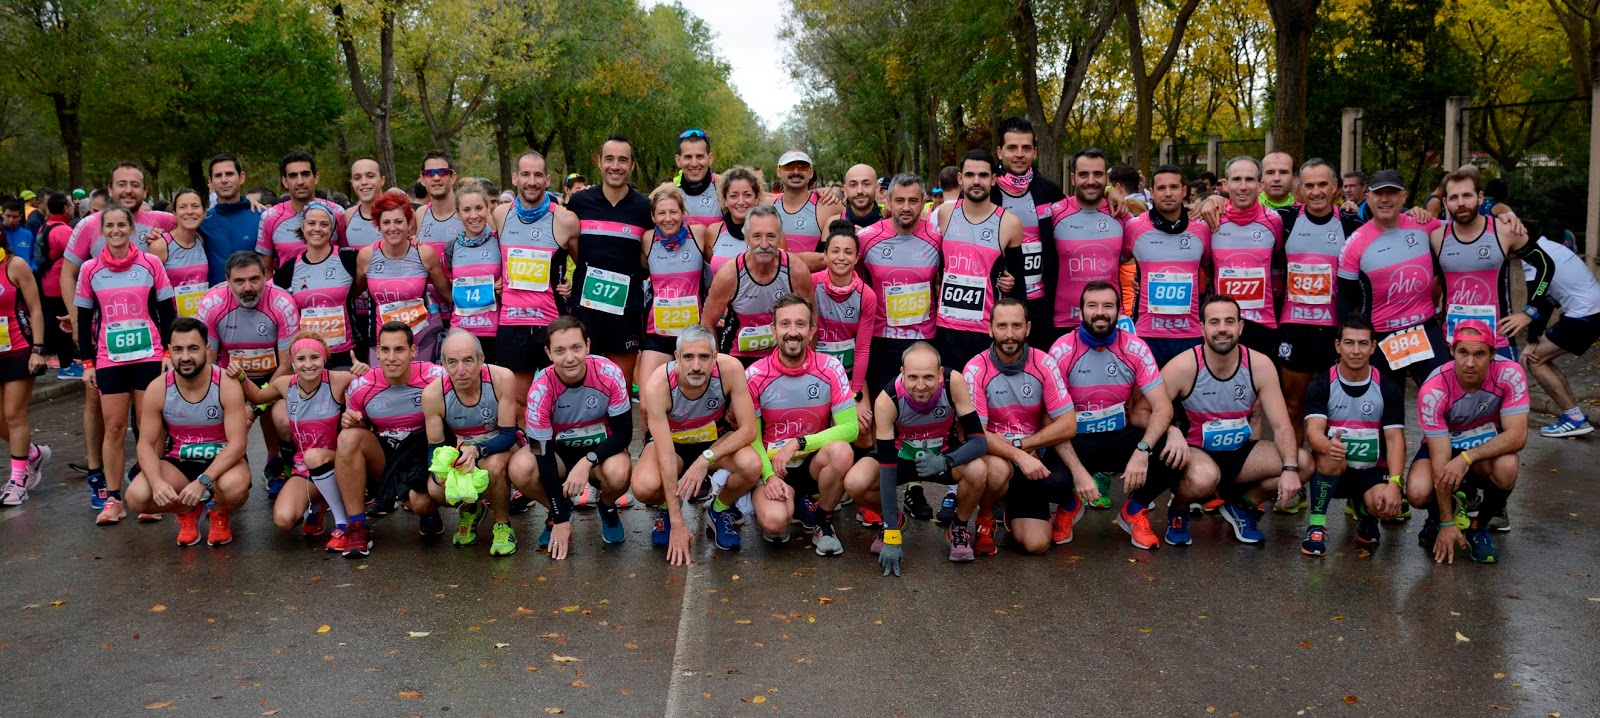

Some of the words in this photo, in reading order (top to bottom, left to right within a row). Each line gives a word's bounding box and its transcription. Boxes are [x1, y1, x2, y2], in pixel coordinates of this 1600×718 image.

[511, 260, 545, 277] 1072
[592, 282, 620, 299] 317
[1225, 280, 1260, 295] 1277
[1293, 276, 1324, 291] 384
[465, 289, 481, 302] 14
[944, 286, 982, 305] 6041
[1155, 285, 1187, 300] 806
[893, 294, 926, 313] 1255
[662, 309, 691, 324] 229
[305, 319, 340, 335] 1422
[115, 332, 142, 348] 681
[1388, 333, 1420, 354] 984
[1086, 417, 1117, 432] 555
[1211, 431, 1245, 447] 366
[1314, 481, 1332, 512] Kalenji
